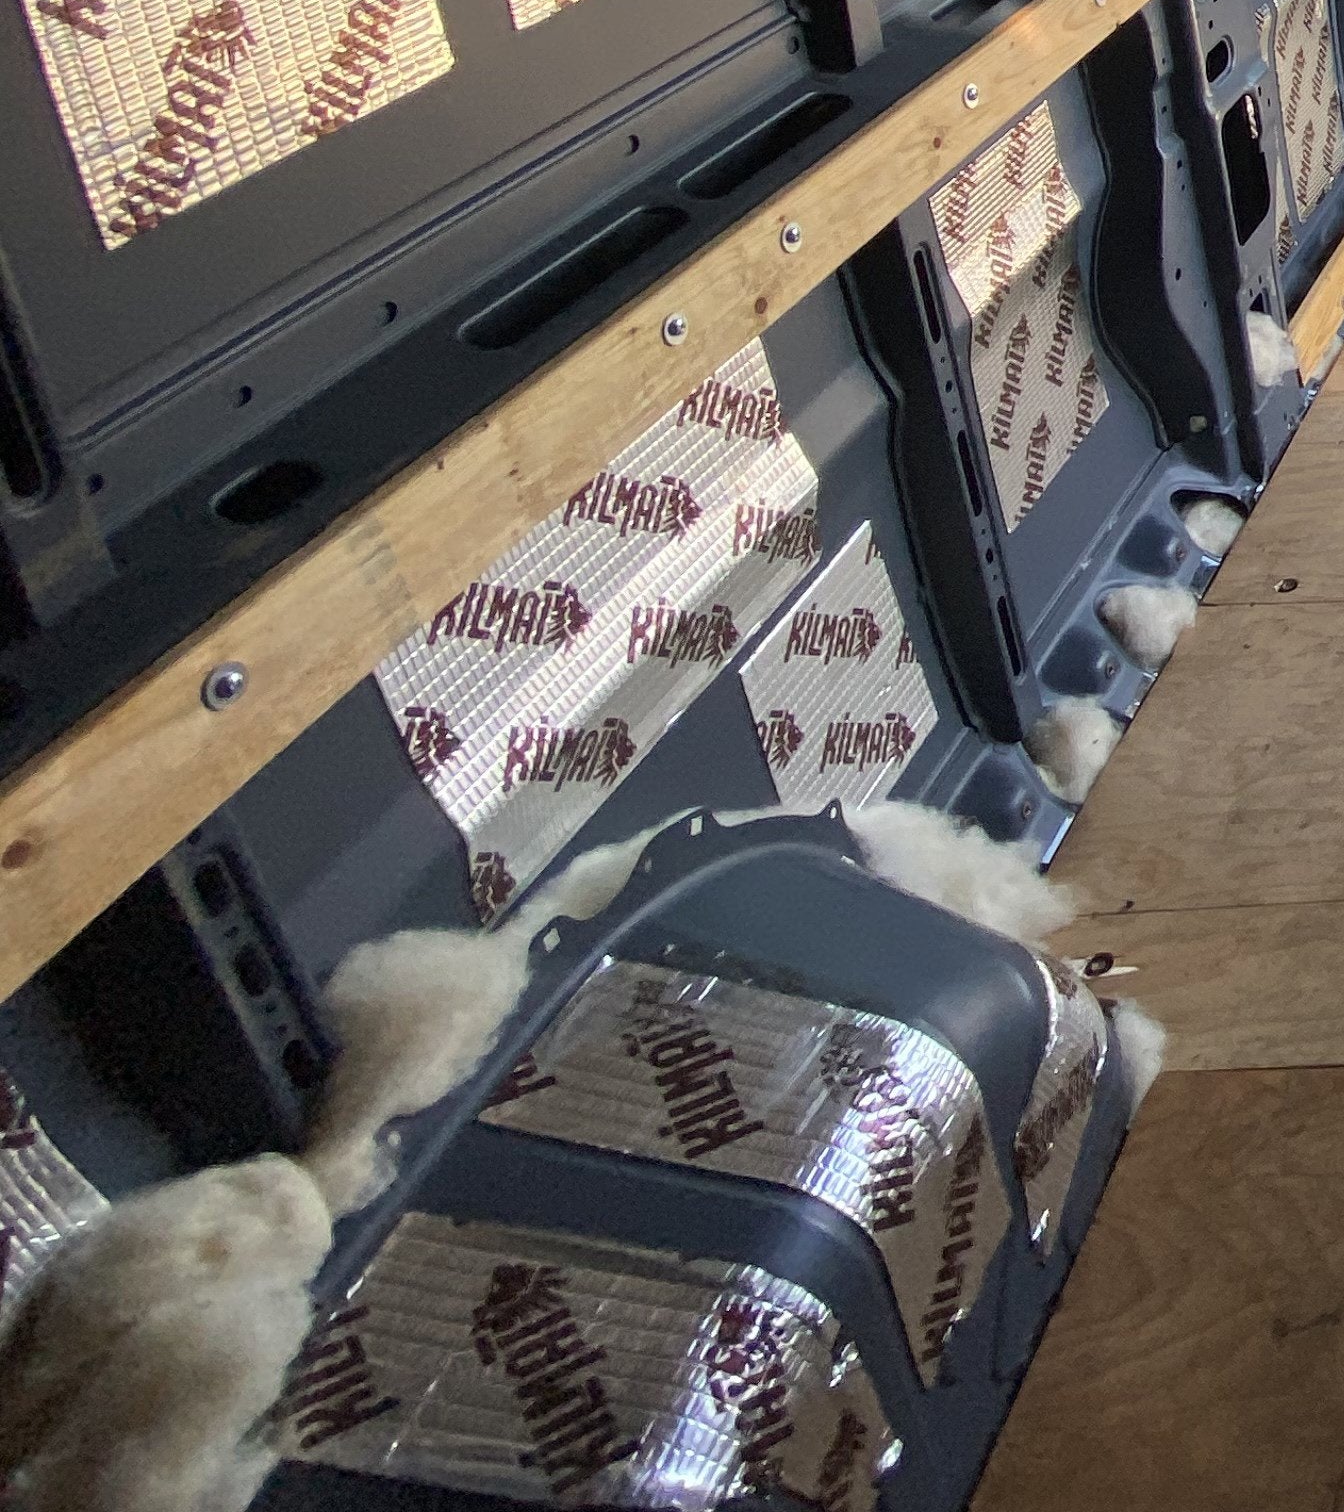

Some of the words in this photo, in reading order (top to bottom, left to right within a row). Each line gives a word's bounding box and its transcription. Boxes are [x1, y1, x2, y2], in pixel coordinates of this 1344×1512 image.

[1285, 65, 1305, 134] KILMAT
[1296, 137, 1315, 207] KILMAT
[974, 240, 1014, 349] KILMAT
[1044, 284, 1076, 387] KILMAT
[991, 331, 1027, 451] KILMAT
[627, 597, 727, 668] KILMAT
[785, 603, 865, 664] KILMAT
[504, 715, 618, 791] KILMAT
[819, 713, 897, 773] KILMAT
[622, 1018, 764, 1158] KILMAT
[475, 1308, 640, 1494] KILMAT
